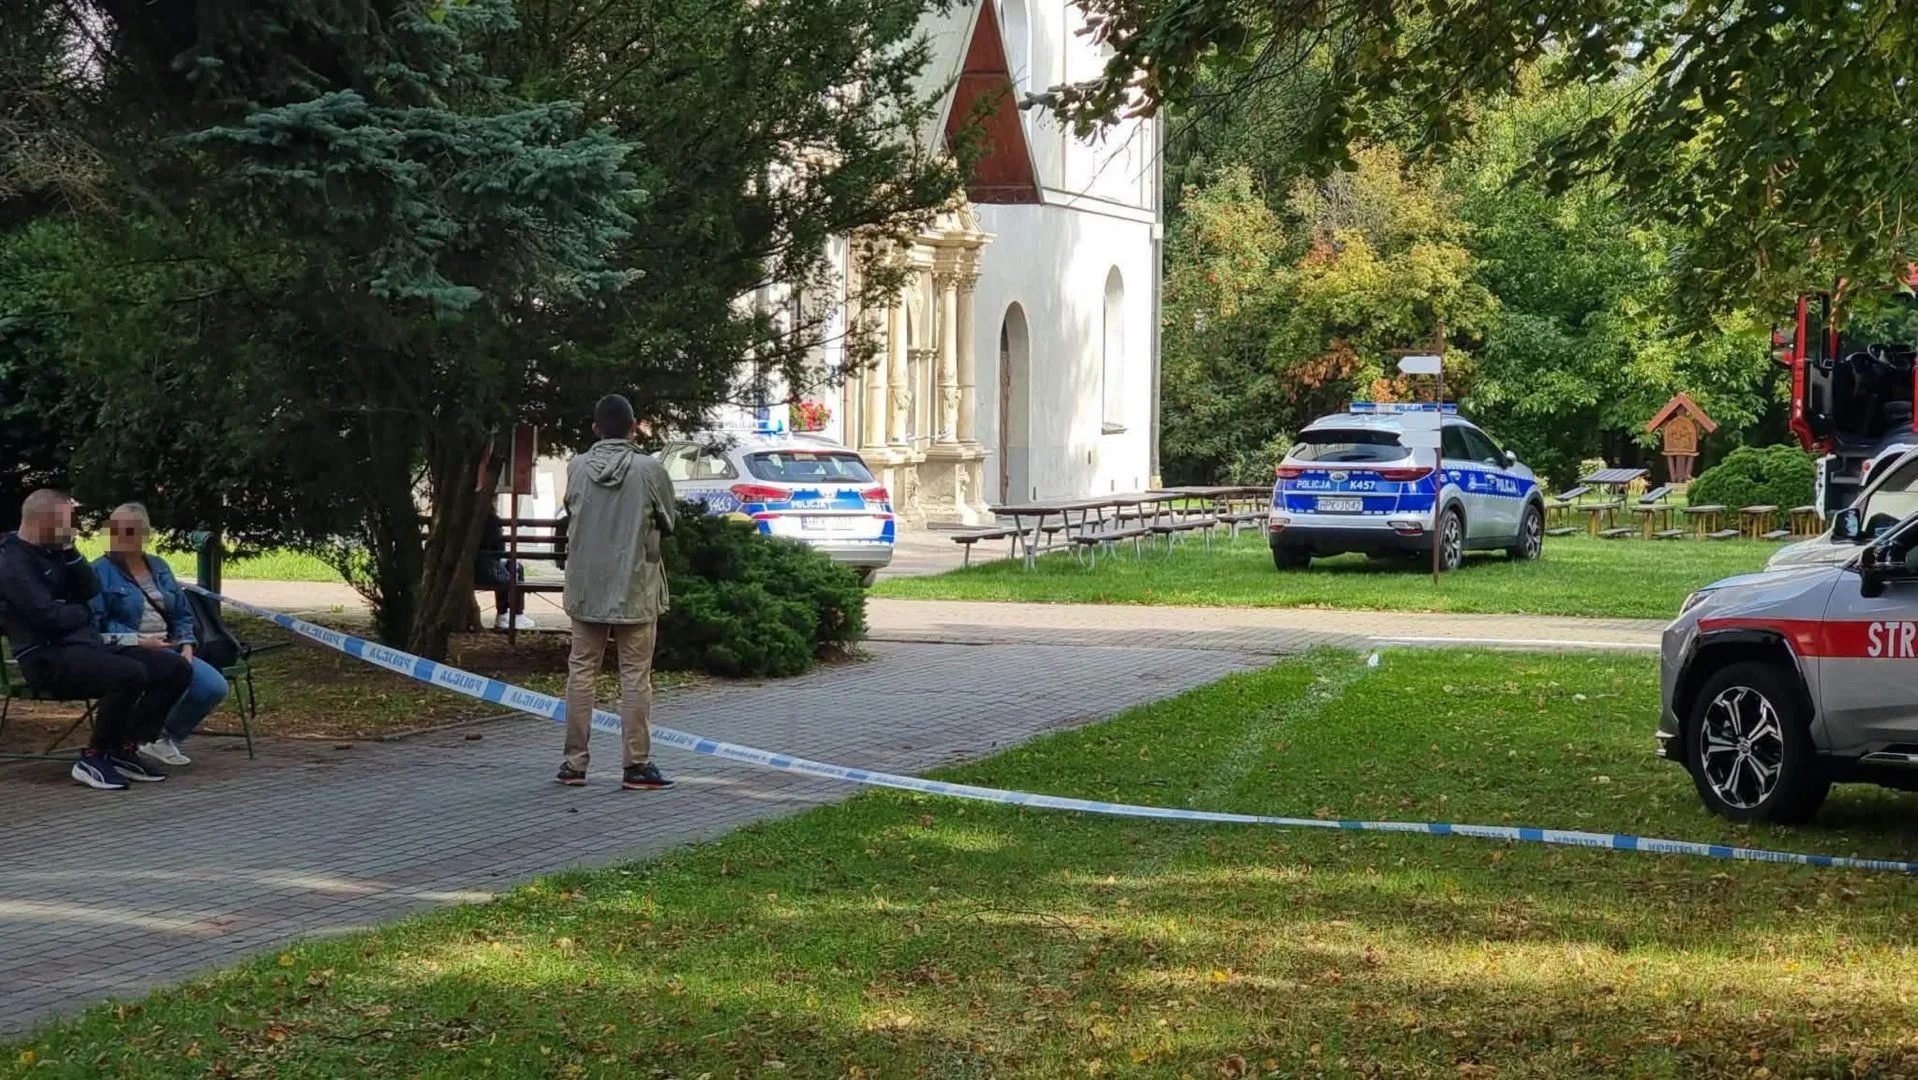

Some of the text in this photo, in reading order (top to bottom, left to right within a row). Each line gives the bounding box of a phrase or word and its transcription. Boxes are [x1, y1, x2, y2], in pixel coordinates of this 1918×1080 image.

[1394, 403, 1421, 412] POLICJA
[1296, 480, 1376, 490] POLICJA K457
[1495, 478, 1518, 493] POLICJA
[1867, 621, 1917, 657] STR
